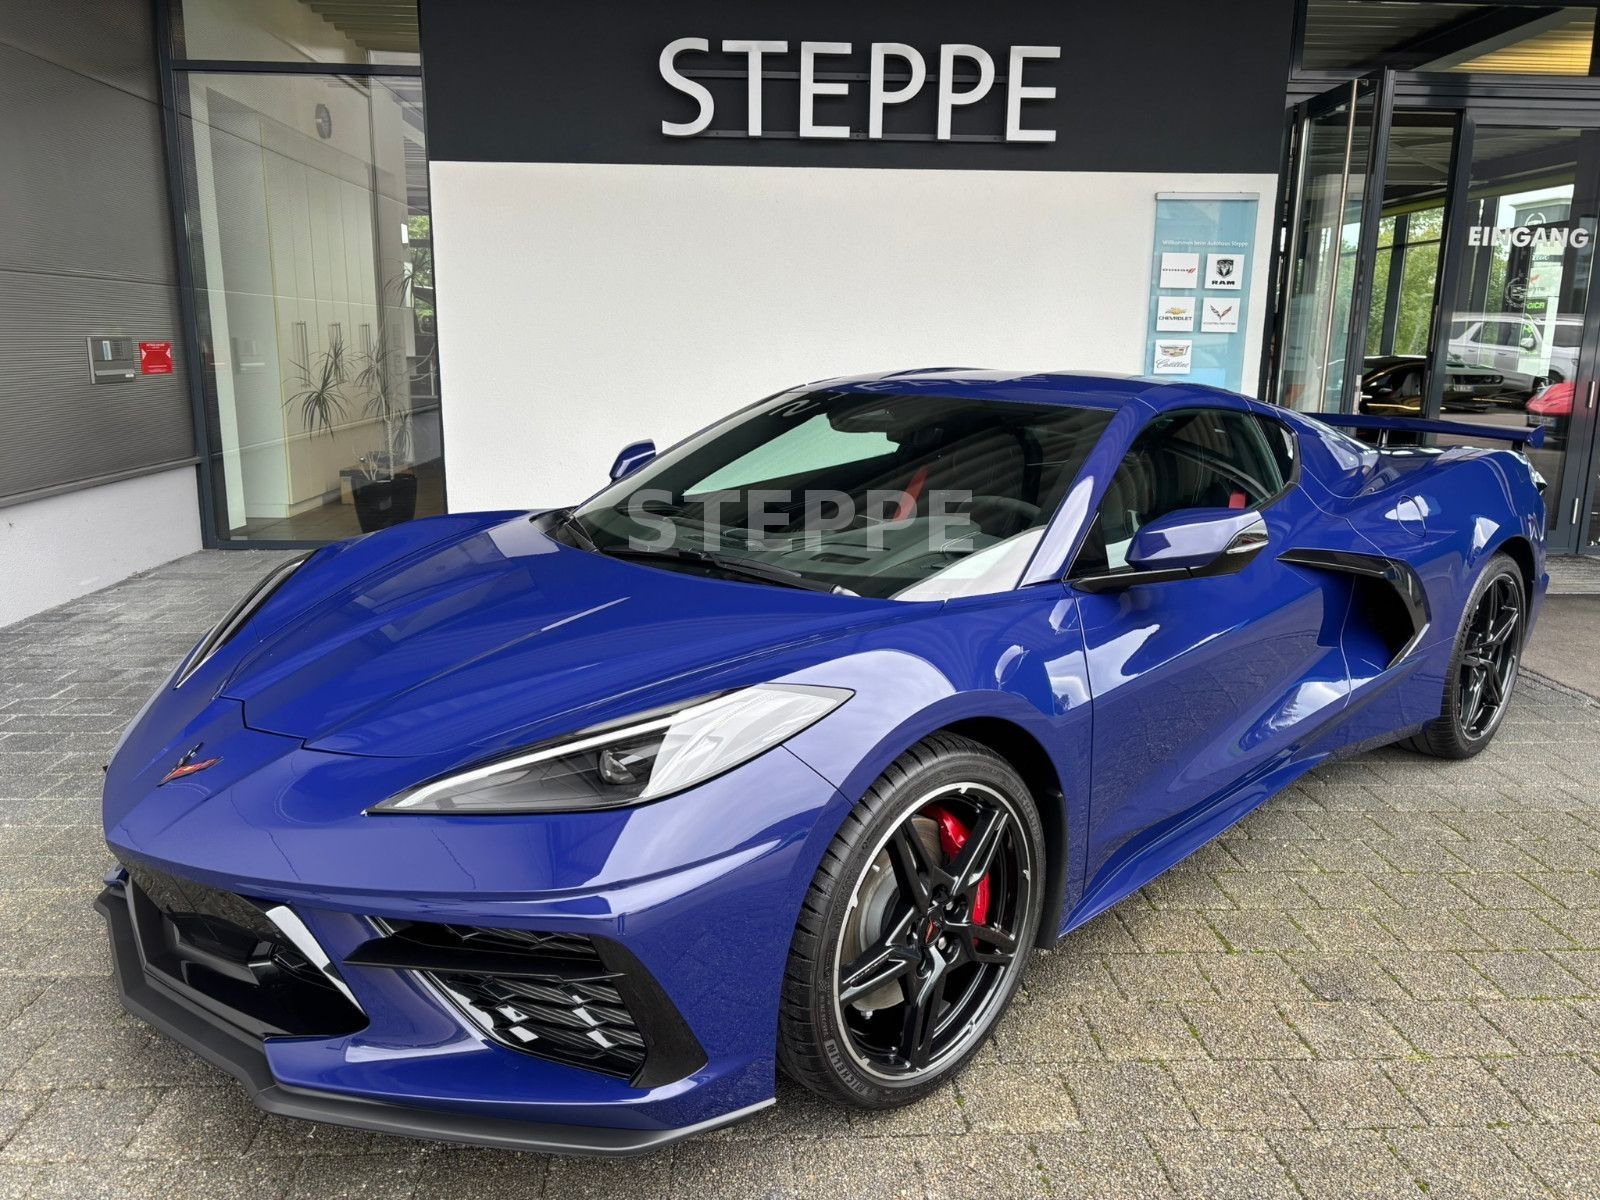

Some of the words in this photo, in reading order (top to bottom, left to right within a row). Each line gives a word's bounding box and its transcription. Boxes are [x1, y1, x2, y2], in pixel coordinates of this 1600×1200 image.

[659, 37, 1062, 142] STEPPE
[1468, 226, 1589, 249] EINGANG
[1155, 359, 1190, 369] Cadillac
[826, 1043, 868, 1094] MICHELIN
